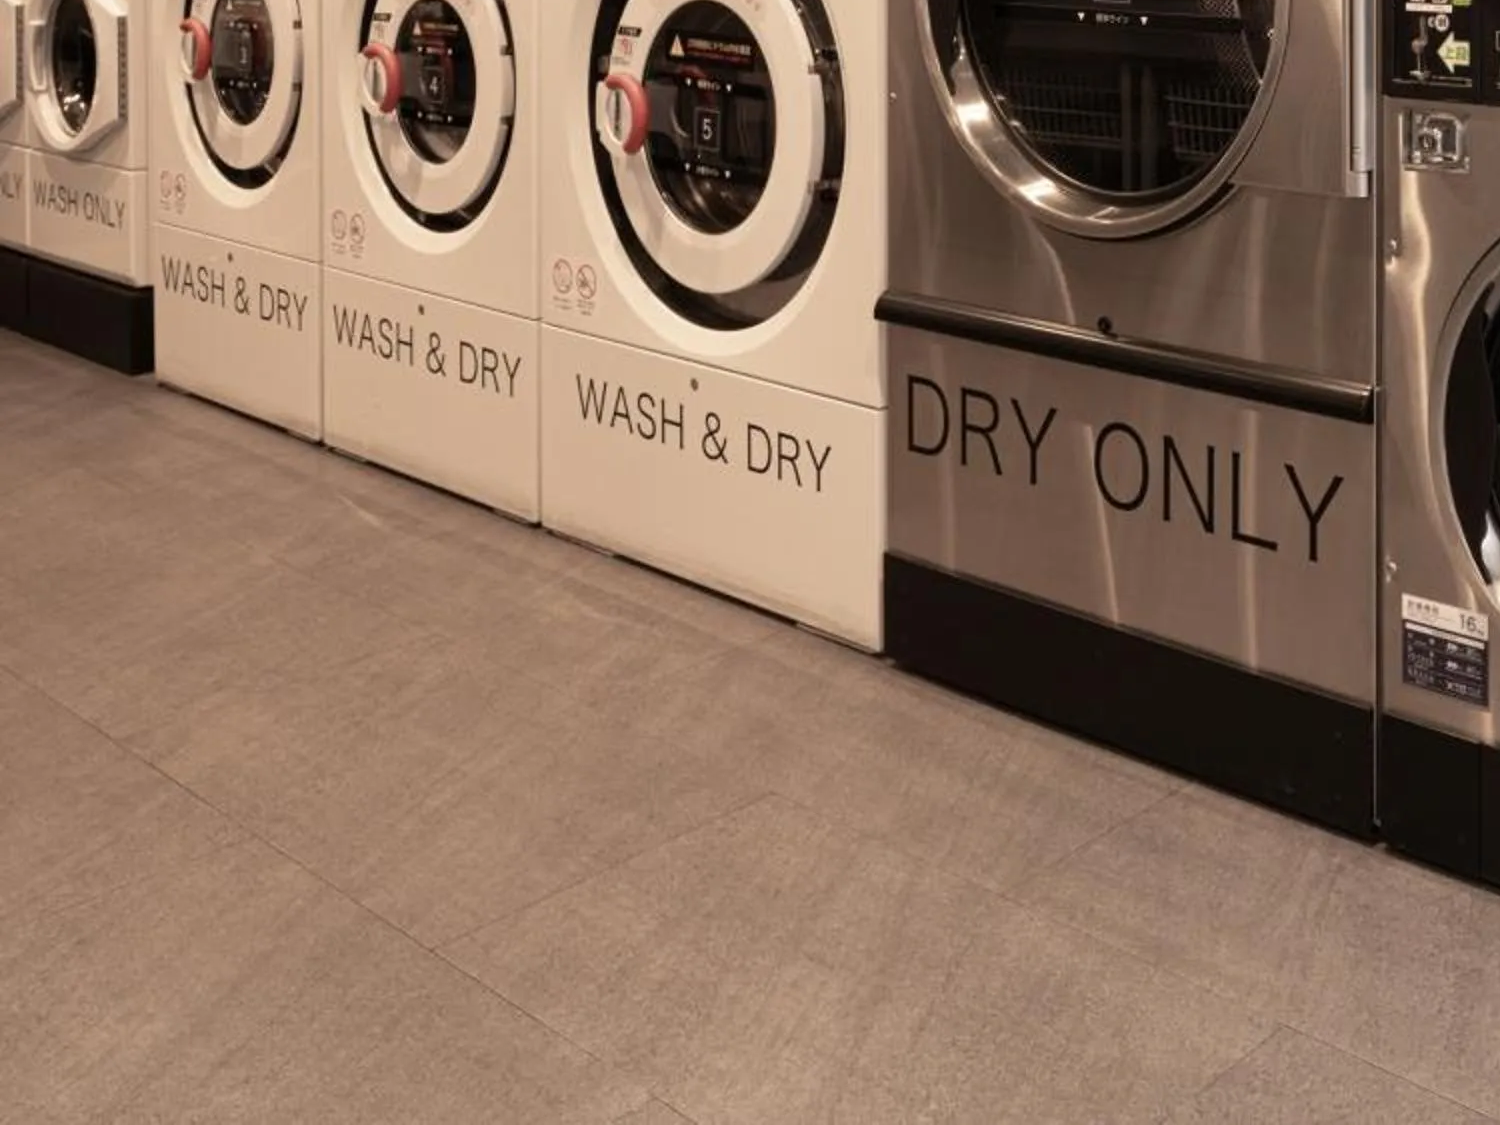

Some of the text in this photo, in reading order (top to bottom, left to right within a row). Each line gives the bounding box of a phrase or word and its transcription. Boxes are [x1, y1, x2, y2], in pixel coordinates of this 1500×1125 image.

[429, 75, 439, 94] 4
[703, 118, 713, 140] 5
[33, 179, 126, 230] WASH ONLY
[161, 254, 308, 332] WASH & DRY
[333, 303, 522, 398] WASH & DRY
[575, 373, 832, 492] WASH & DRY
[907, 374, 1345, 563] DRY ONLY
